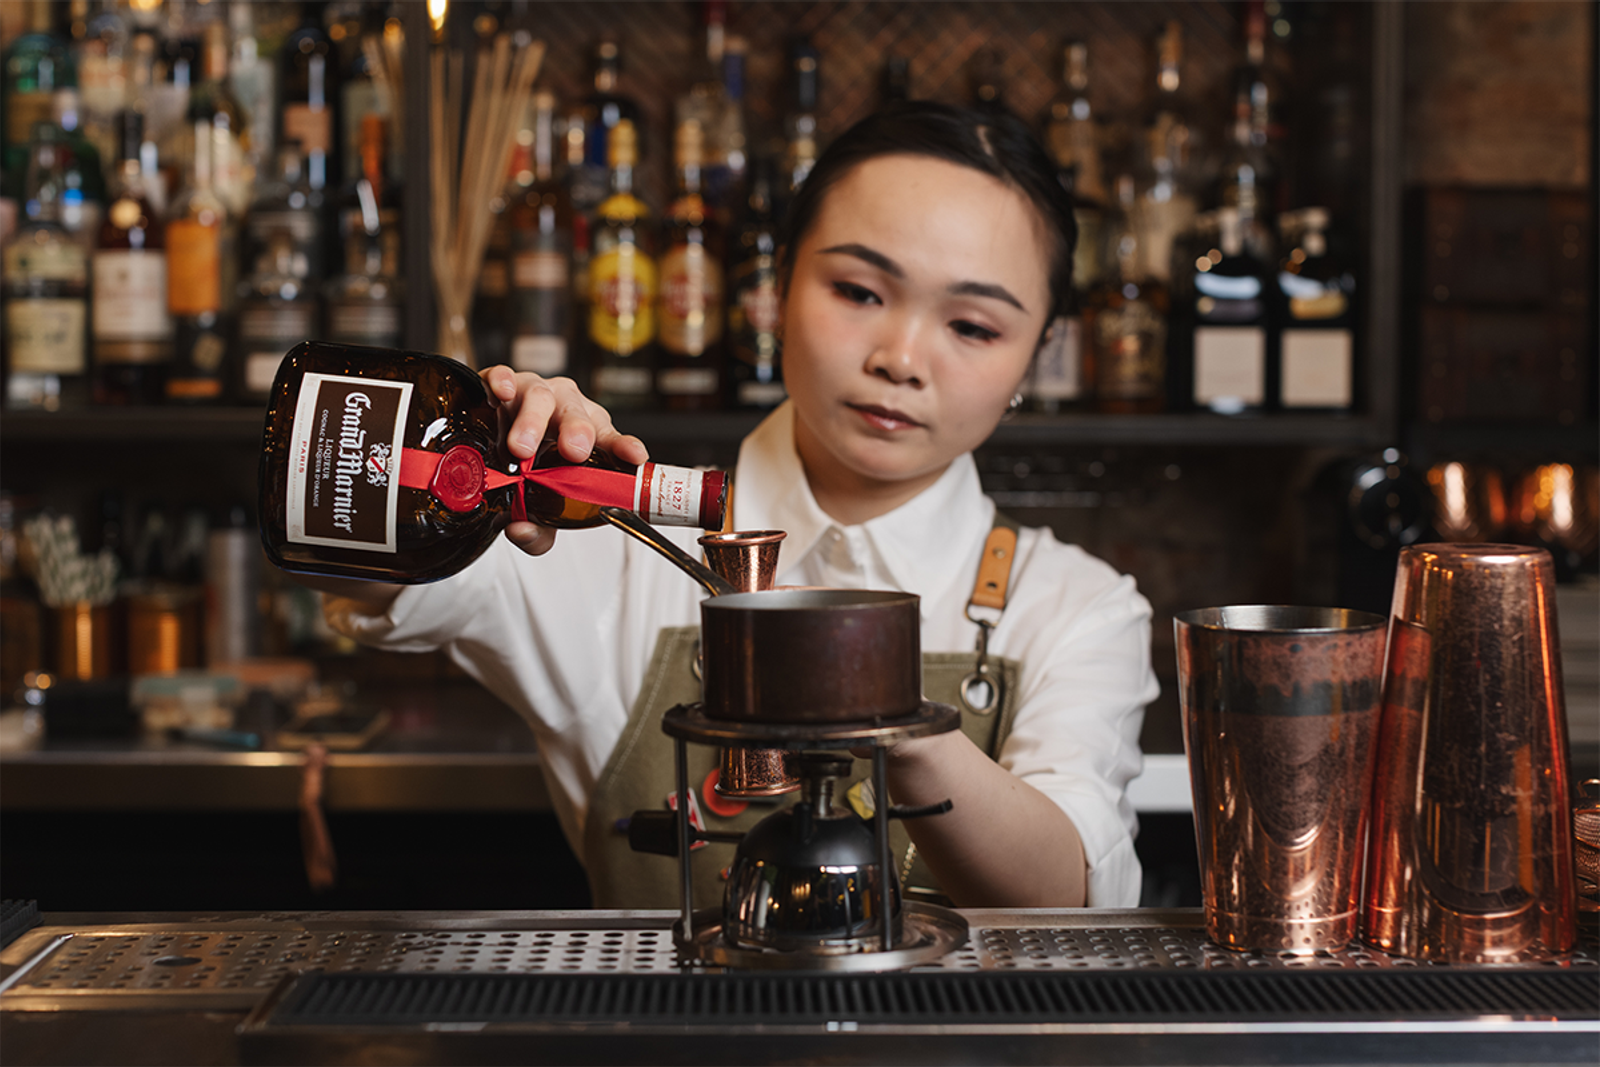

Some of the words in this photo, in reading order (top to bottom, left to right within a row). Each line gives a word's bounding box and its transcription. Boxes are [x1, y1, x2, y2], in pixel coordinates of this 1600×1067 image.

[319, 409, 329, 437] COGNAC
[339, 392, 372, 449] Grand
[298, 440, 308, 473] PARIS
[315, 444, 324, 473] LIQUEUR
[322, 438, 334, 480] LIQUEUR
[313, 474, 321, 508] D'ORANGE
[333, 446, 364, 533] Marnier
[672, 481, 683, 511] 1827
